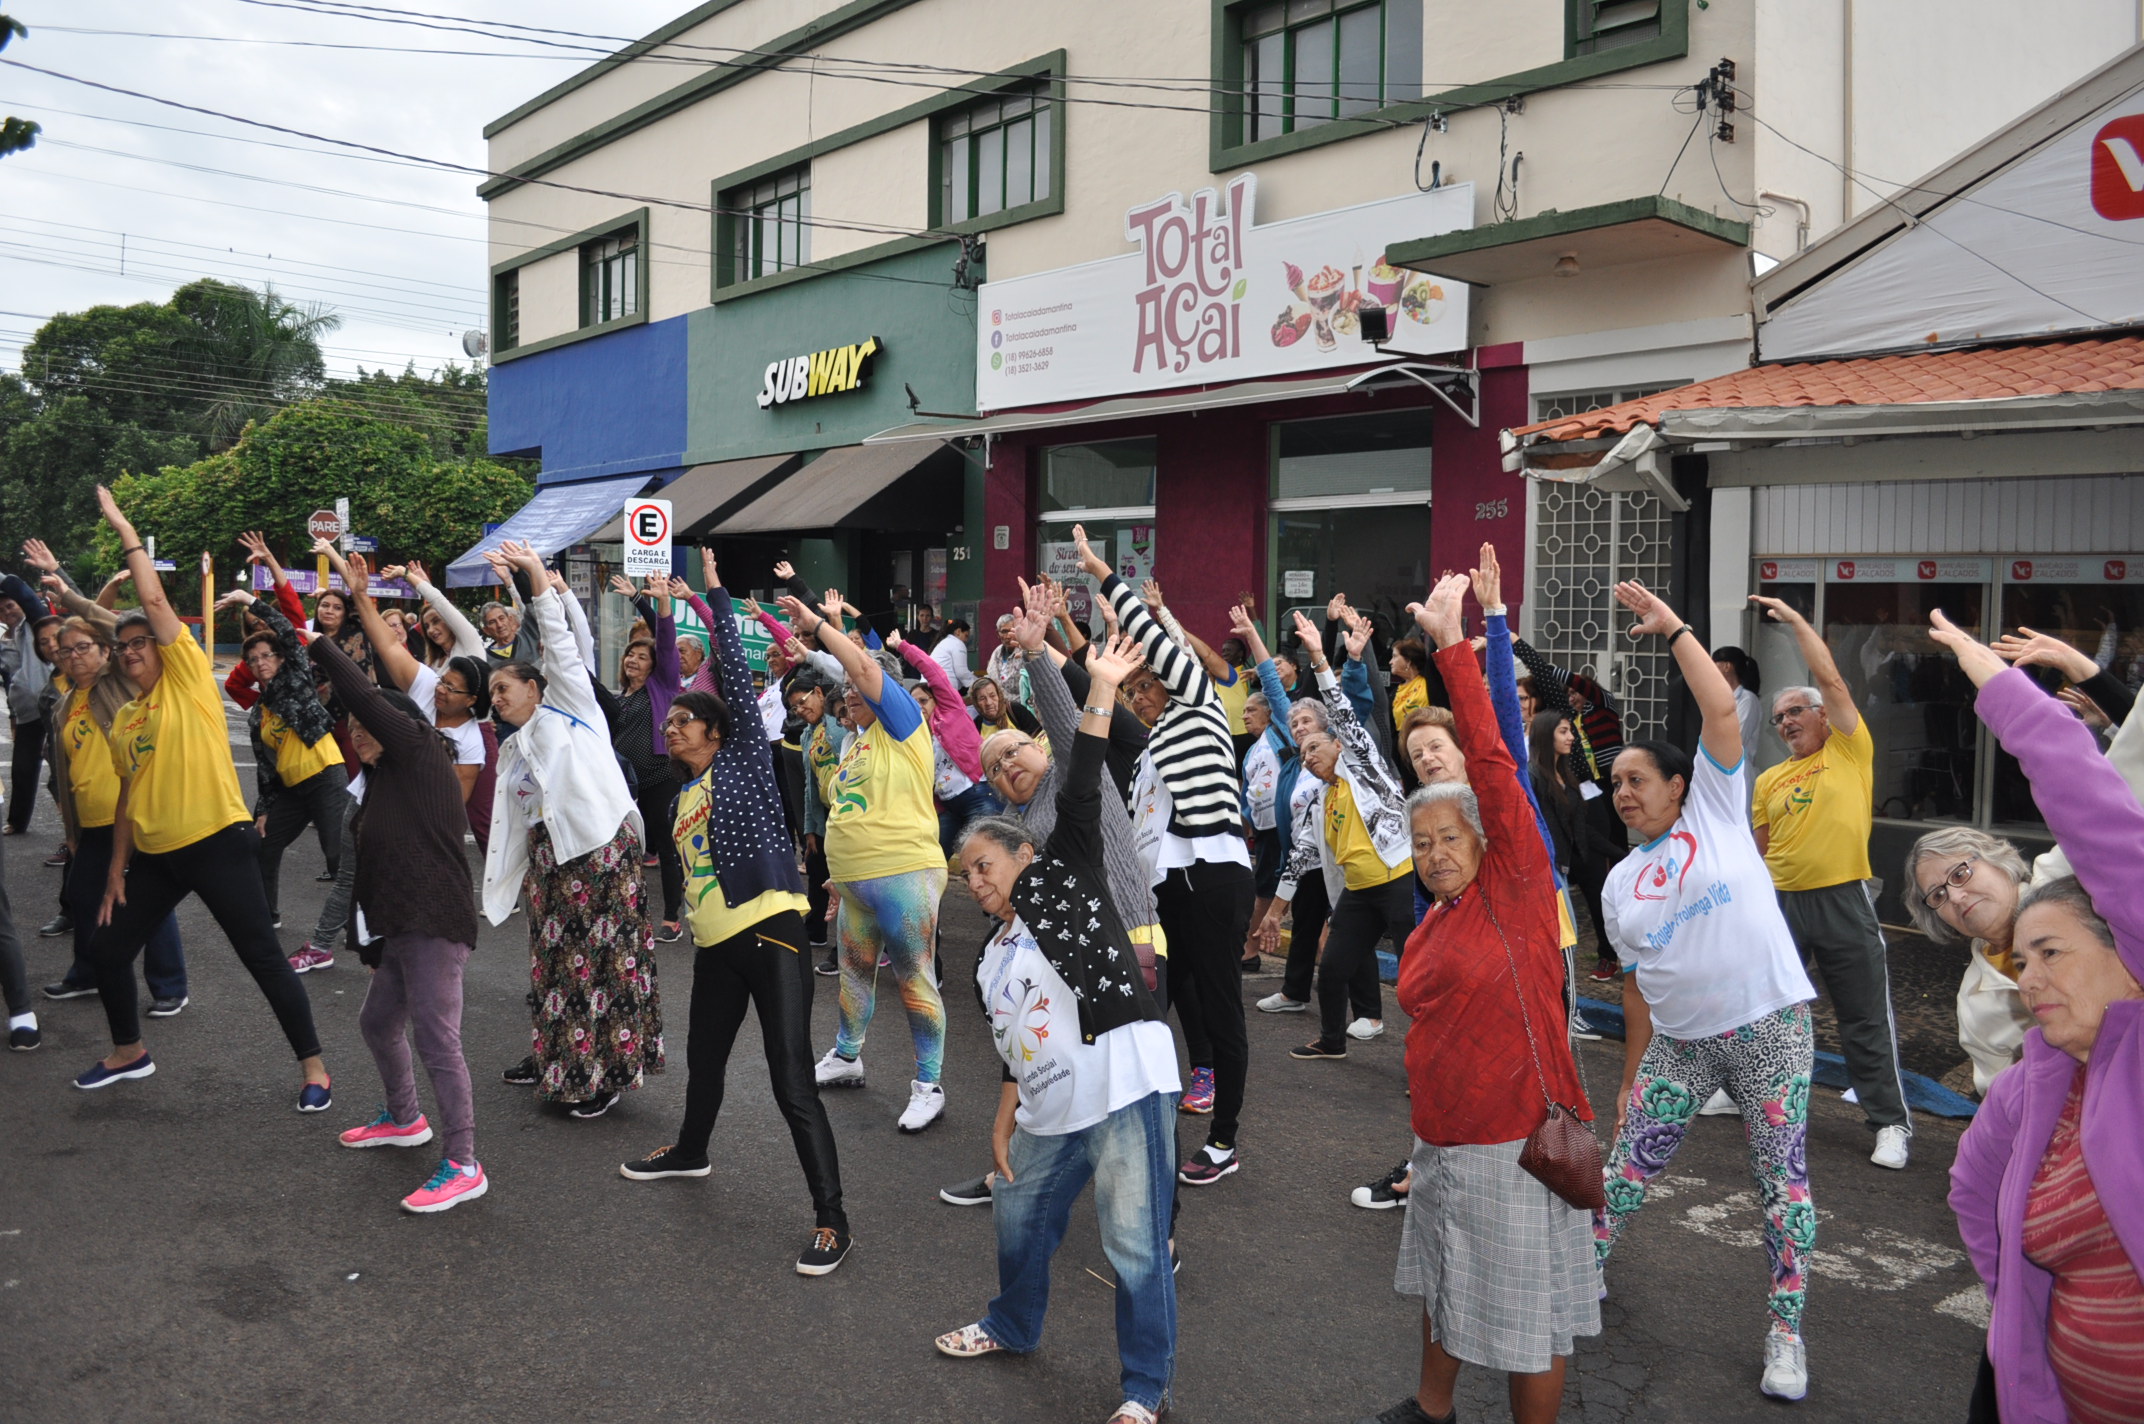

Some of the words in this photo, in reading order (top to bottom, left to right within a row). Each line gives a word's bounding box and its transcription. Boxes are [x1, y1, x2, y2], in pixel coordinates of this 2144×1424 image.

[757, 336, 876, 408] SUBWAY
[1475, 497, 1508, 521] 255
[311, 520, 340, 533] PARE
[640, 513, 658, 538] E
[627, 556, 670, 565] DESCARGA
[632, 549, 659, 557] CARGA
[953, 546, 971, 561] 251
[1707, 880, 1732, 906] Vida
[1024, 1070, 1039, 1083] undo
[1037, 1058, 1058, 1074] Social
